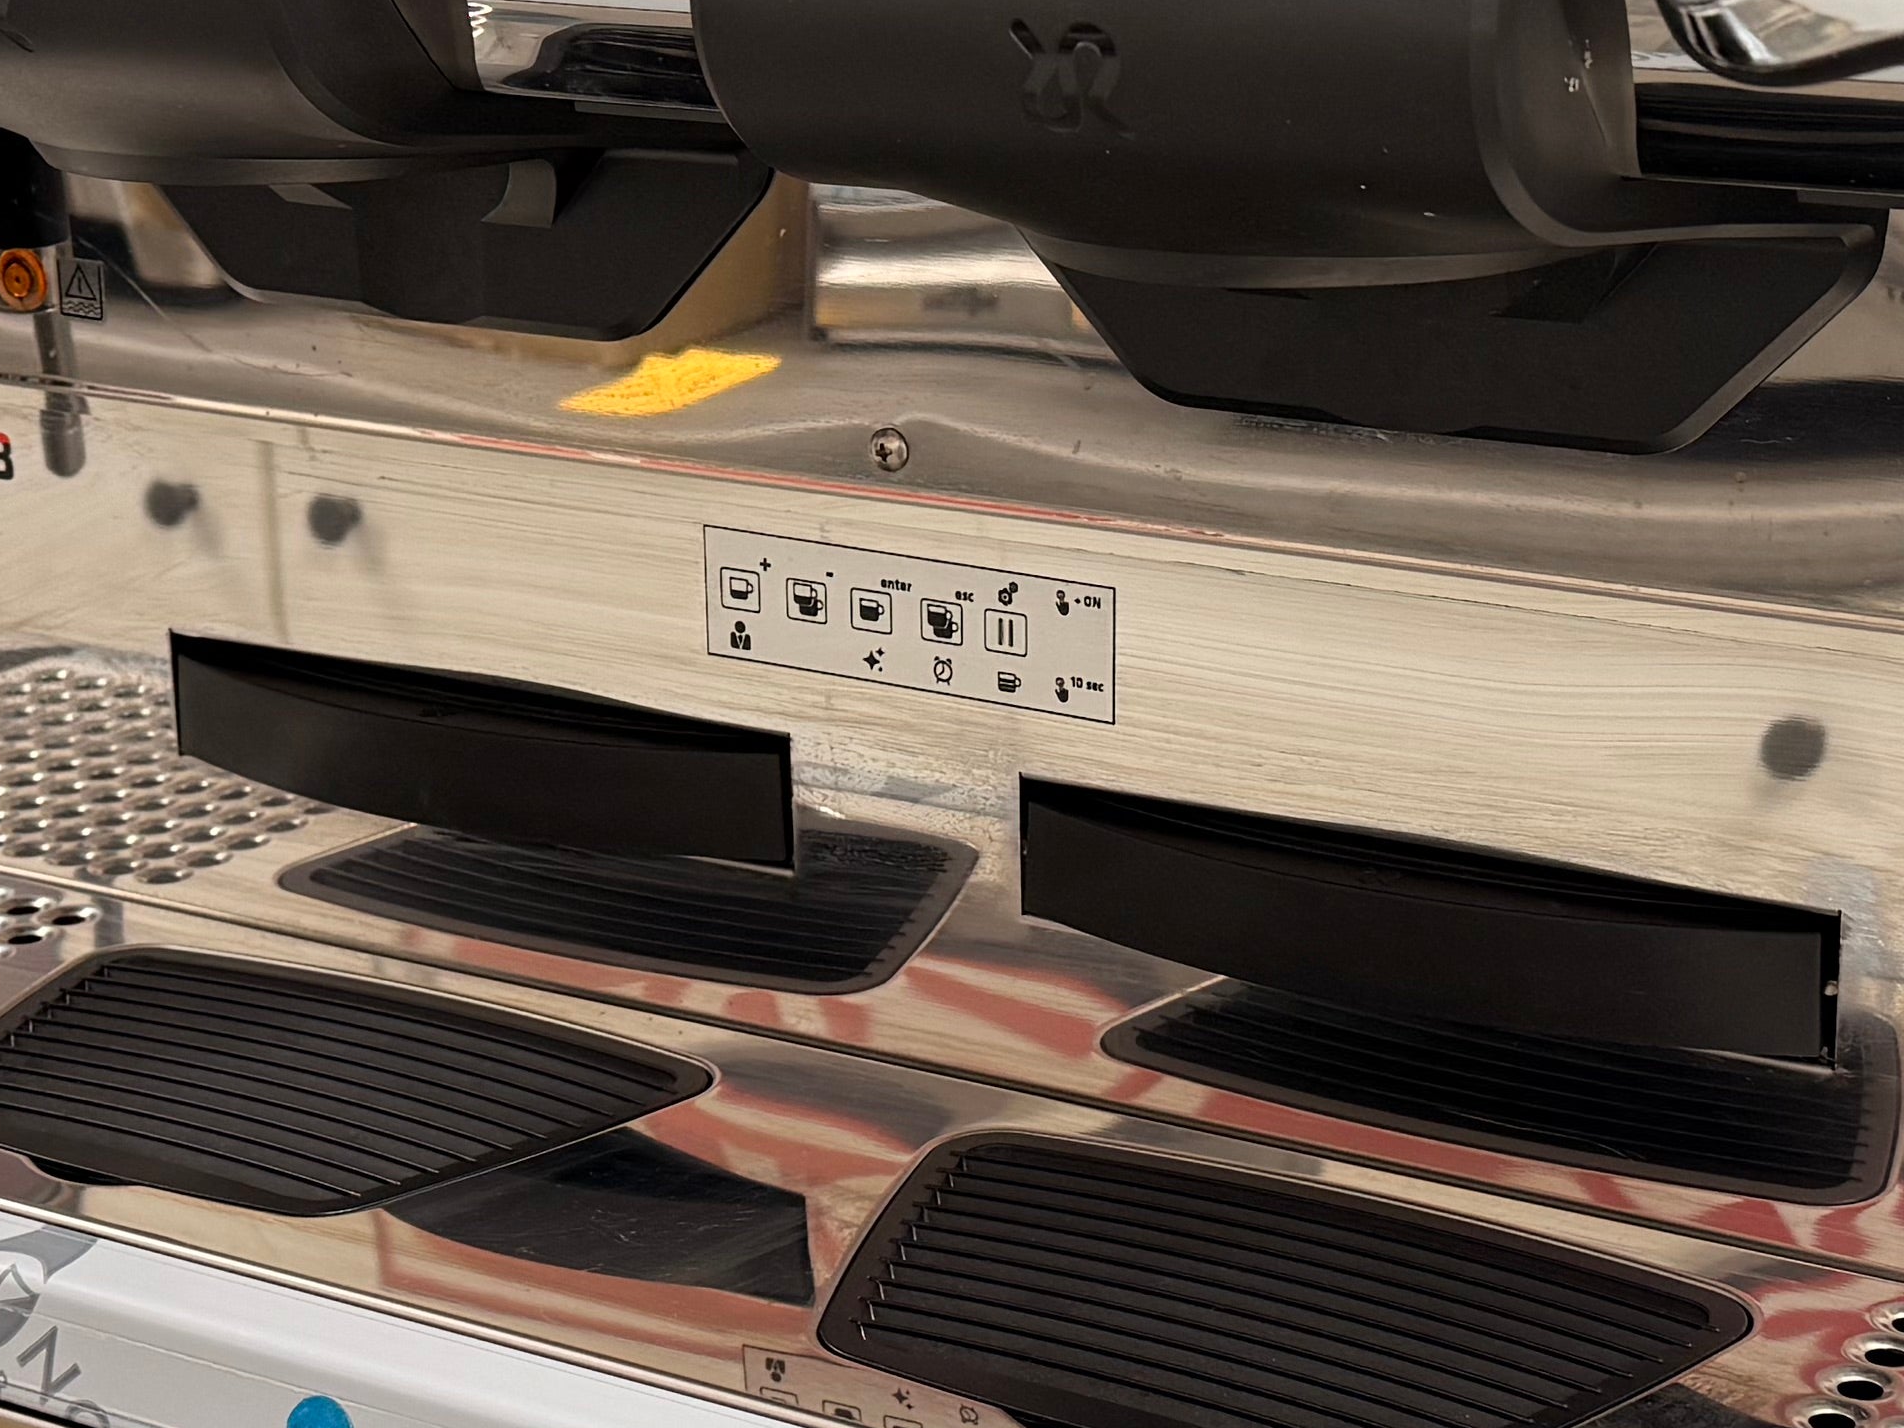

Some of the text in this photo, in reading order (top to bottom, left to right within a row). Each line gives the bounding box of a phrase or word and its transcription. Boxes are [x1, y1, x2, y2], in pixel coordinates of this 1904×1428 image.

[880, 578, 913, 593] enter
[955, 590, 975, 603] esc
[1070, 676, 1105, 693] 10 sec
